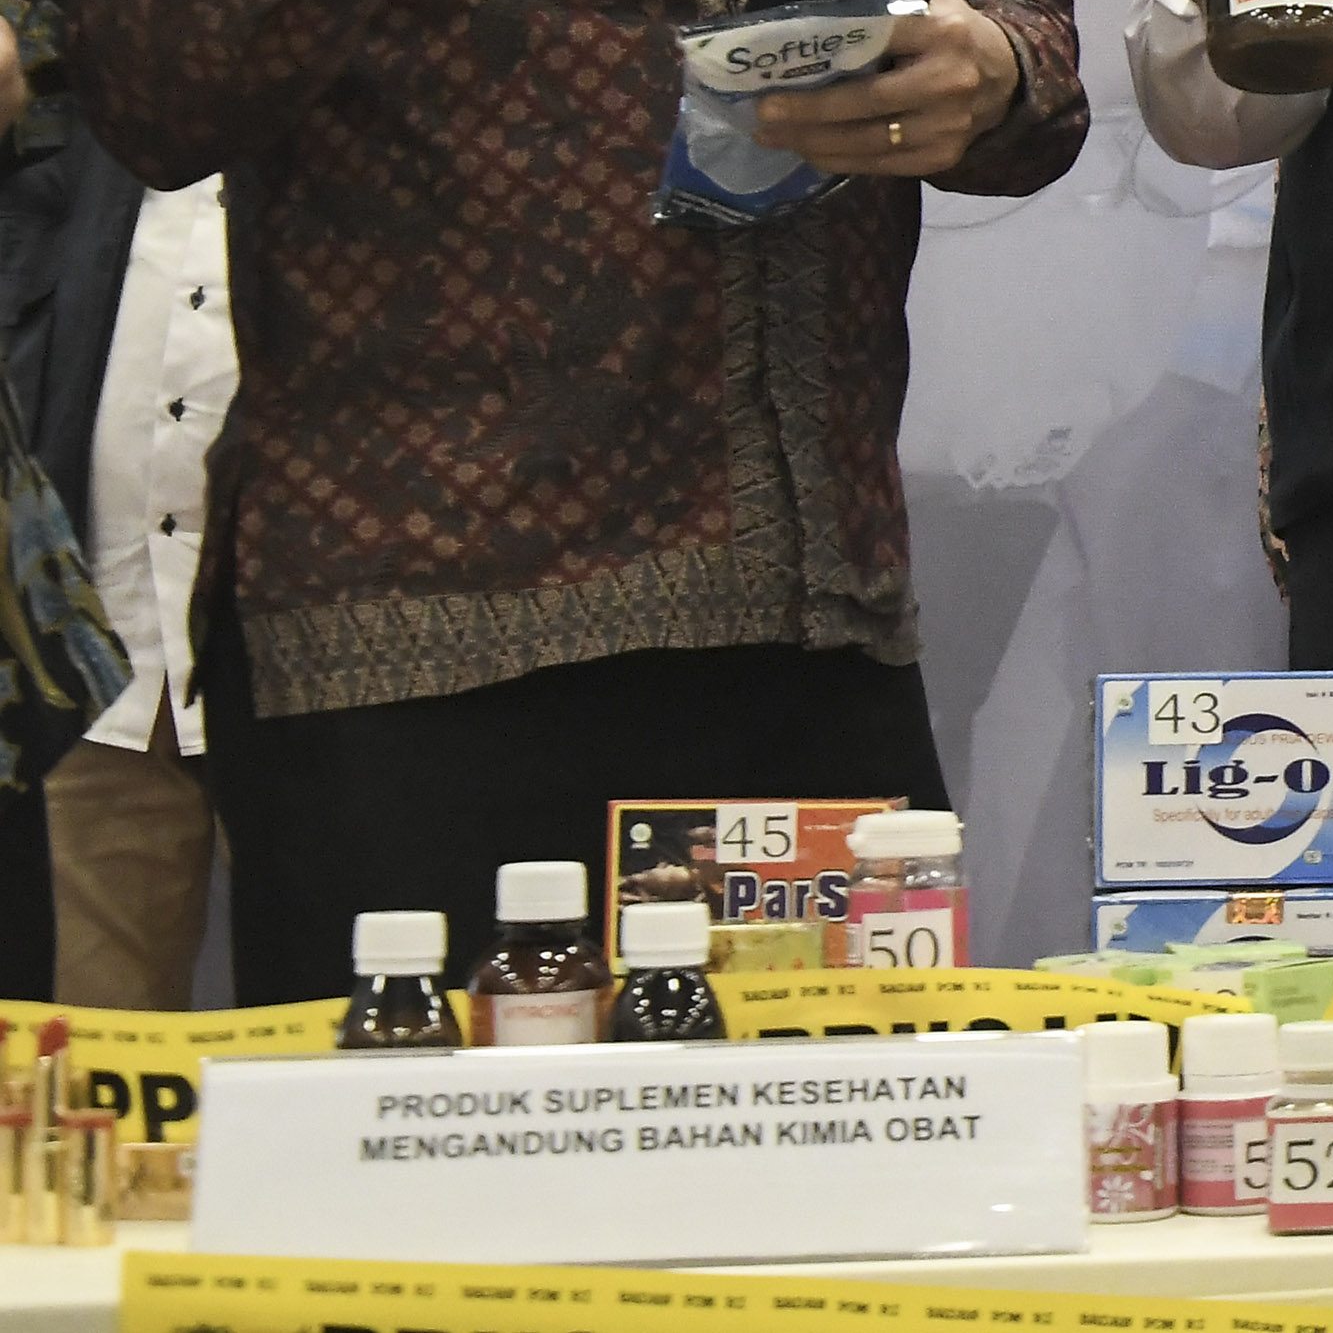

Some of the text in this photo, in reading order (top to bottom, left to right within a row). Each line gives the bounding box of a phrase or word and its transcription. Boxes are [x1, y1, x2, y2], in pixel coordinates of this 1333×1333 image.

[726, 27, 871, 75] Softies
[1154, 692, 1221, 734] 43
[721, 814, 793, 859] 45
[868, 927, 940, 969] 50
[378, 1074, 968, 1121] PRODUK SUPLEMEN KESEHATAN
[360, 1114, 982, 1162] MENGANDUNG BAHAN KIMIA OBAT
[1243, 1139, 1268, 1190] 5
